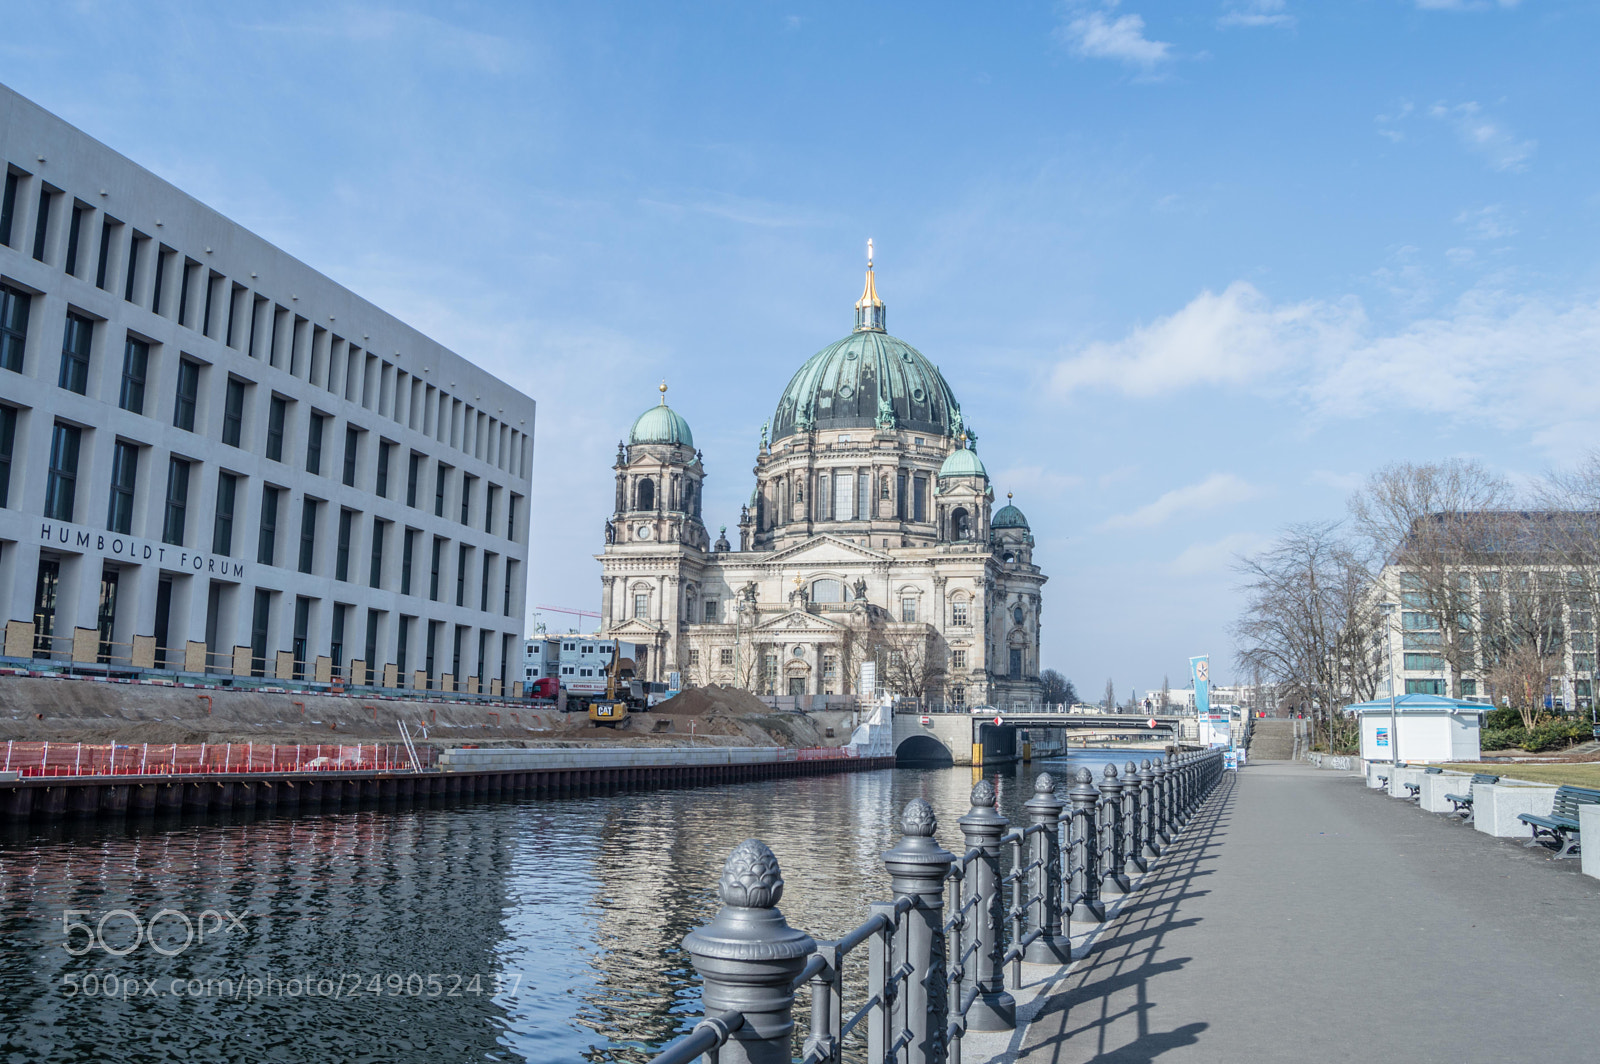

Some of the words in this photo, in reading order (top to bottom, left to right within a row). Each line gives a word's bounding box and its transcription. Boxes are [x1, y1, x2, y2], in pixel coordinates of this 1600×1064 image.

[40, 523, 166, 563] HUMBOLDT
[180, 552, 244, 578] FORUM
[598, 706, 612, 716] CAT
